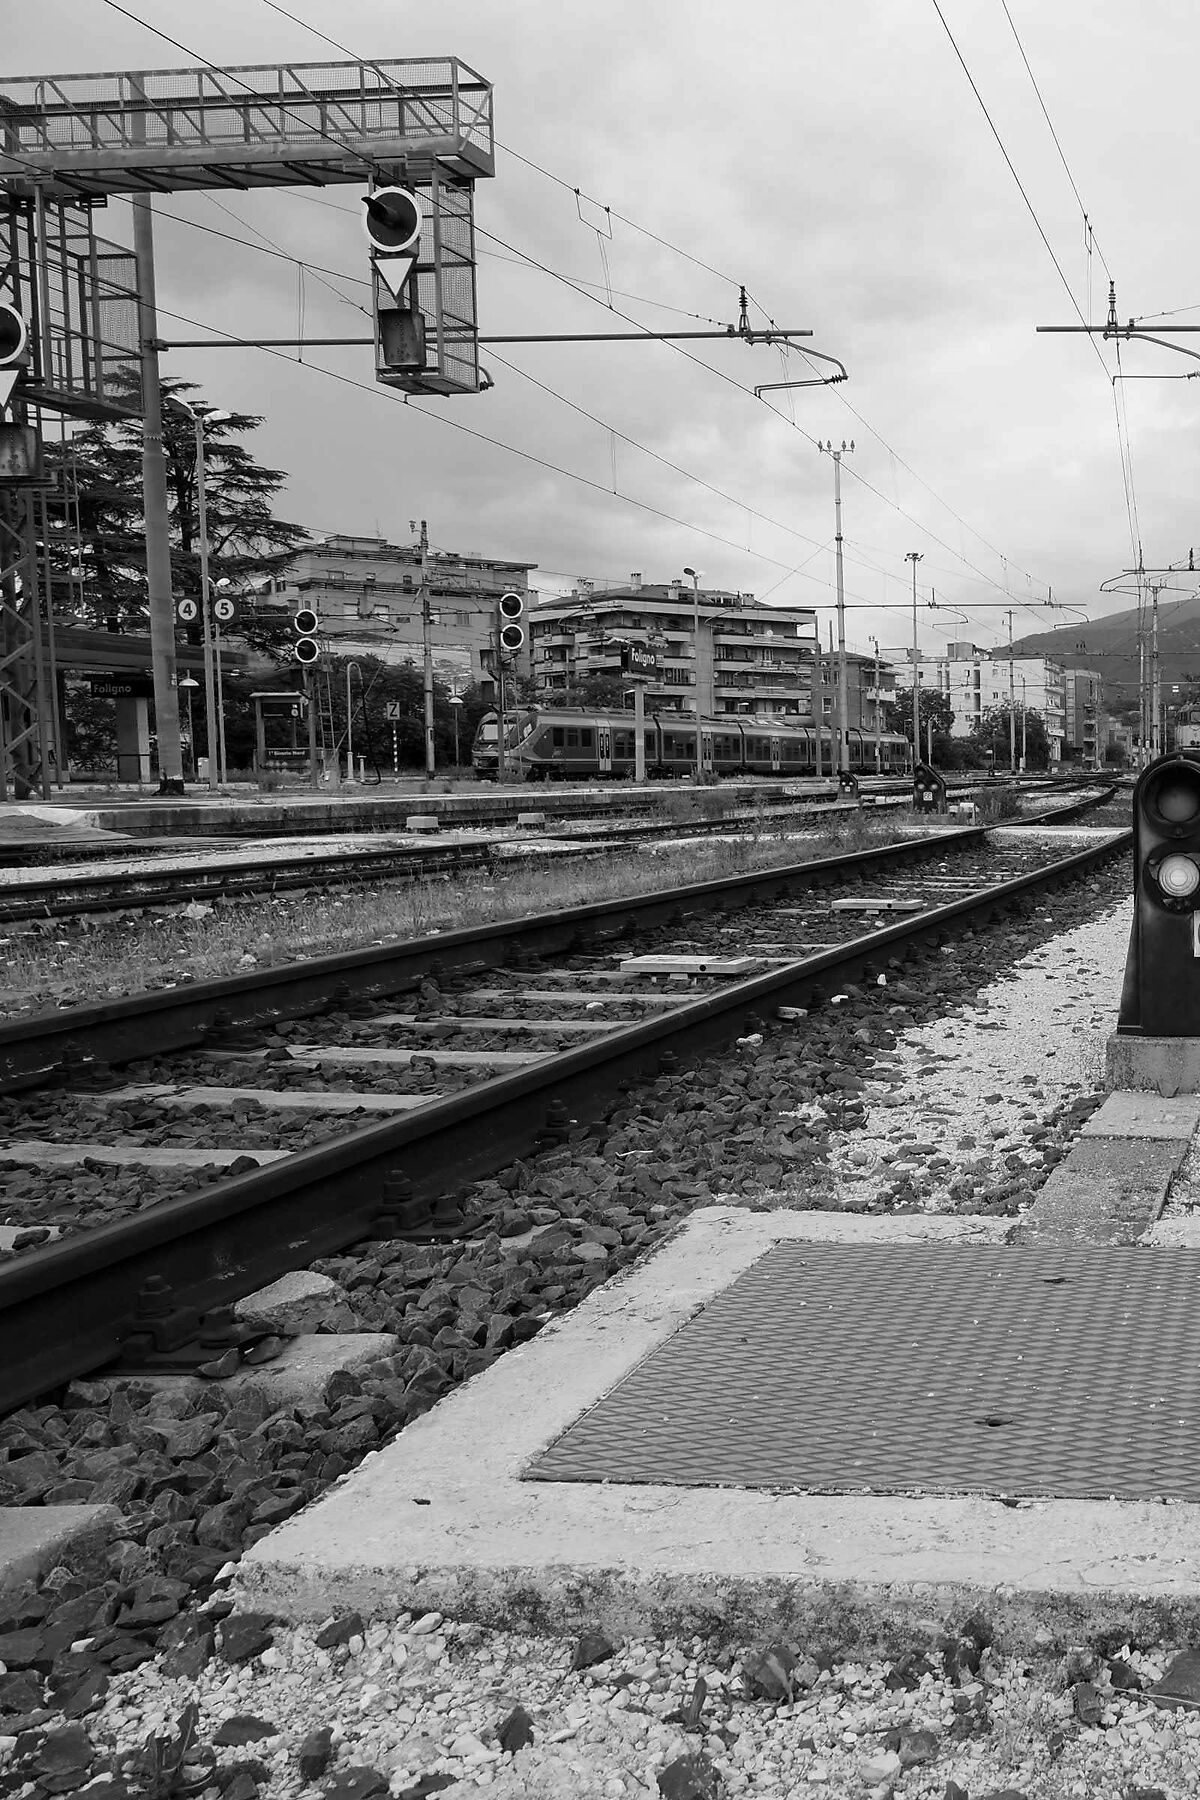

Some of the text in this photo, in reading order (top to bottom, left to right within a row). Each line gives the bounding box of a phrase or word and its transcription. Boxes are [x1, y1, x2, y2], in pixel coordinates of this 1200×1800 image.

[183, 602, 193, 616] 4
[220, 602, 229, 616] 5
[631, 647, 655, 667] Foligno
[93, 683, 132, 695] Foligno
[389, 703, 398, 717] Z
